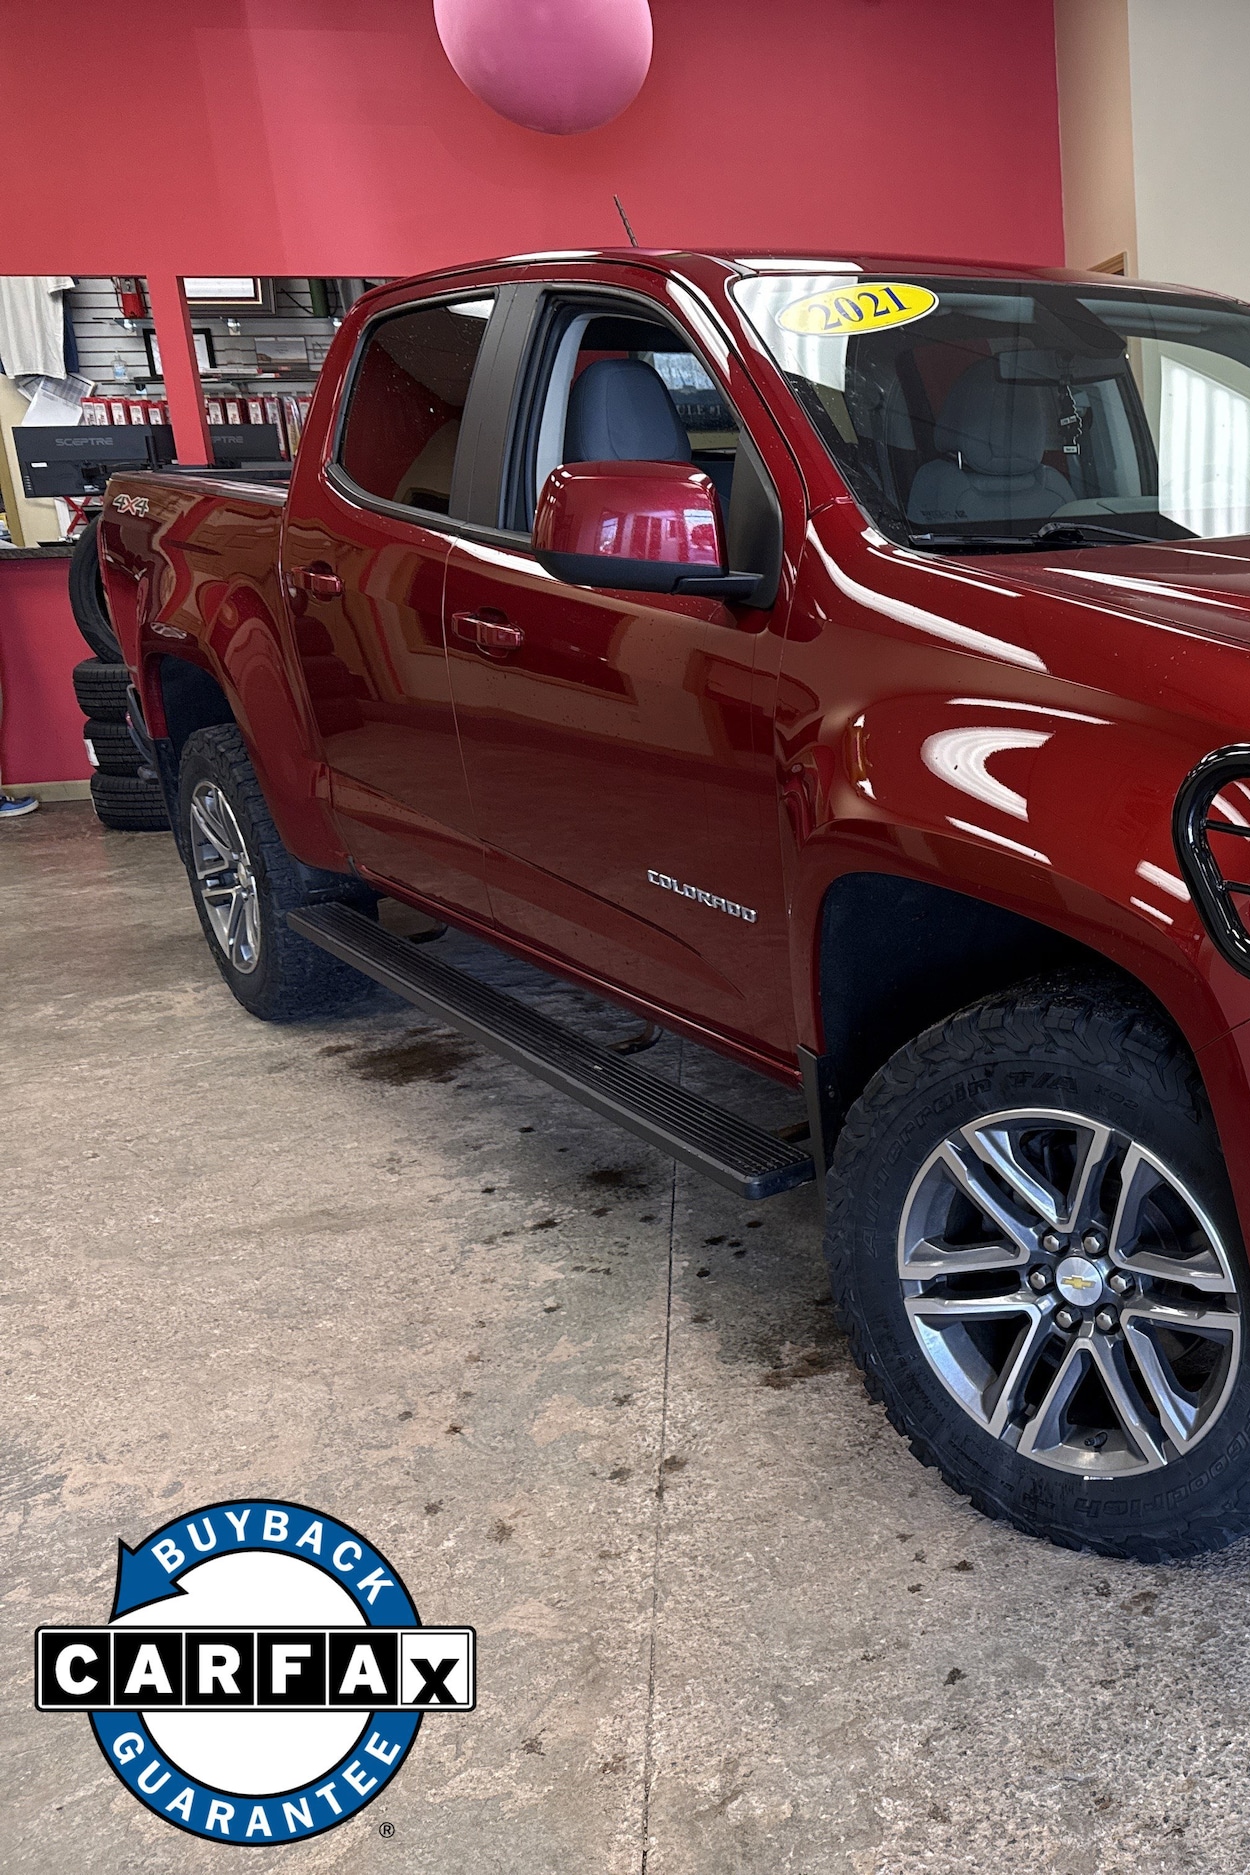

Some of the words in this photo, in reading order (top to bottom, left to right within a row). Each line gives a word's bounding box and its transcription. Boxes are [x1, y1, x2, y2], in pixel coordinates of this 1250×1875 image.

[808, 286, 912, 330] 2021
[55, 436, 114, 447] SCEPTRE
[112, 493, 150, 518] 4X4
[647, 869, 758, 924] COLORADO
